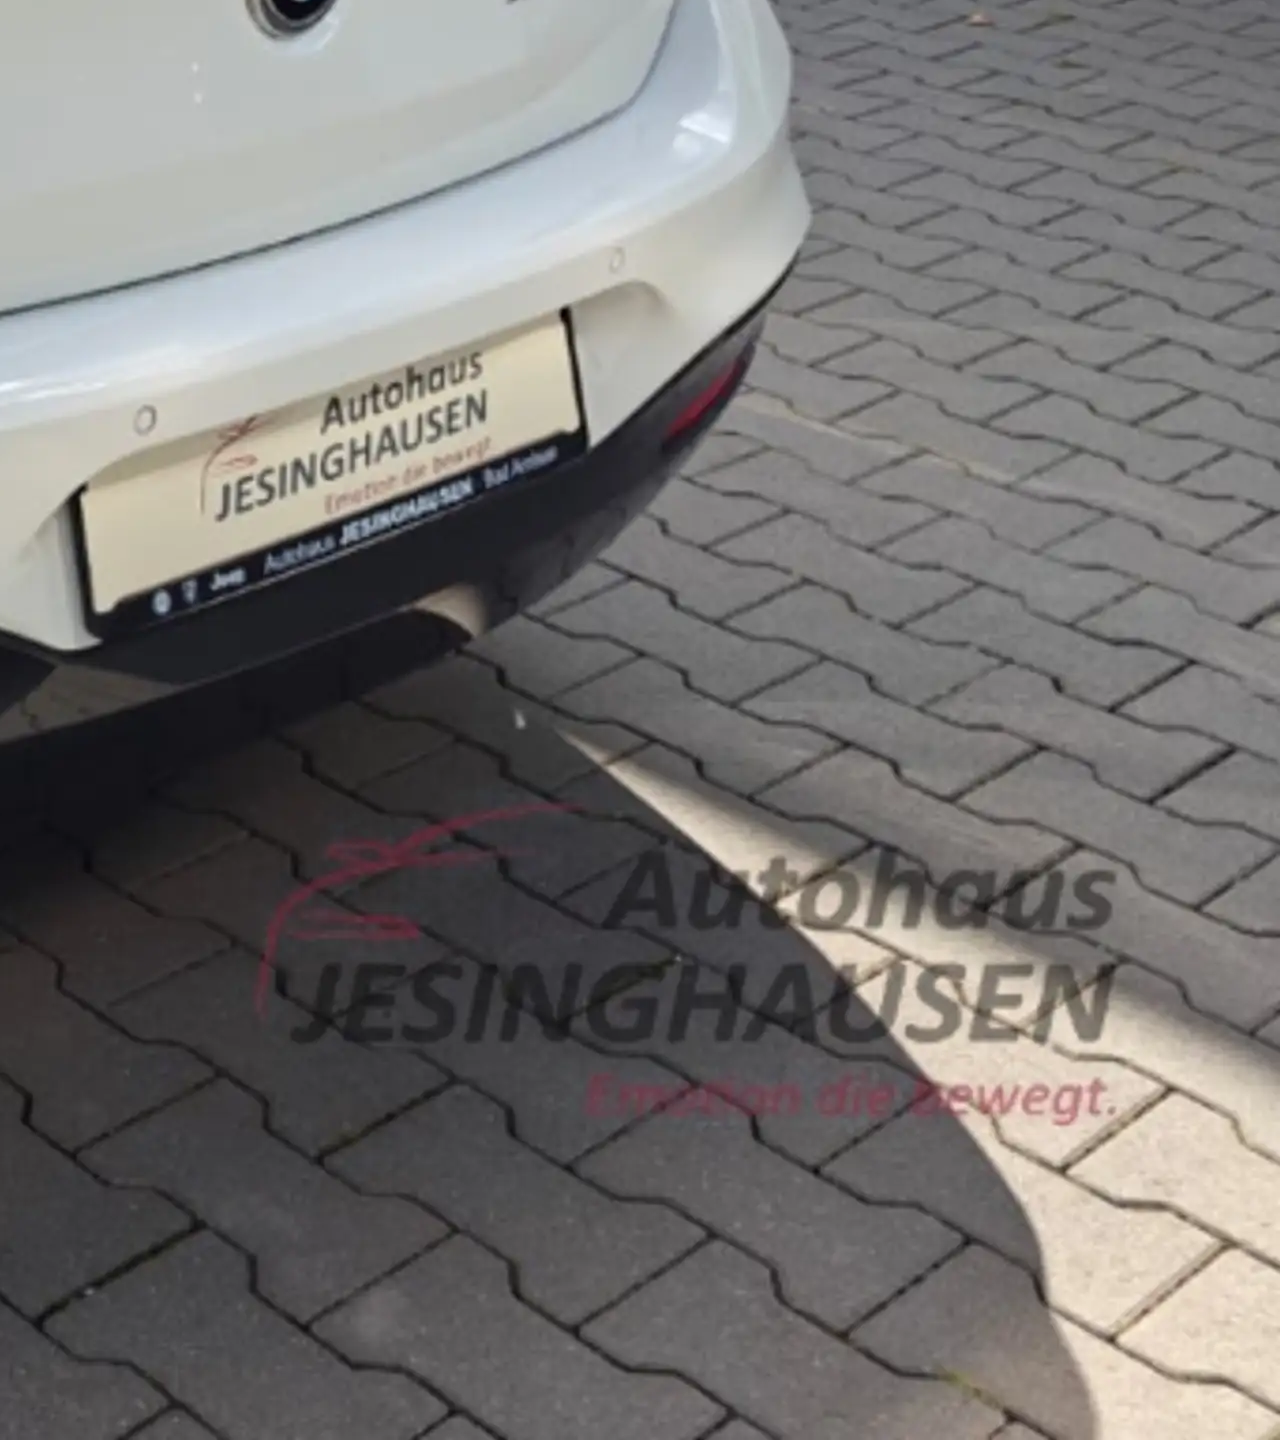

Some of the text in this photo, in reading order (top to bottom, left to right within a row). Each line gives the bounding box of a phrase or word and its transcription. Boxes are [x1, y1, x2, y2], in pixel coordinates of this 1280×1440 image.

[319, 351, 484, 435] Autohaus
[214, 389, 489, 522] JESINGHAUSEN
[340, 476, 474, 547] JESINGHAUSEN
